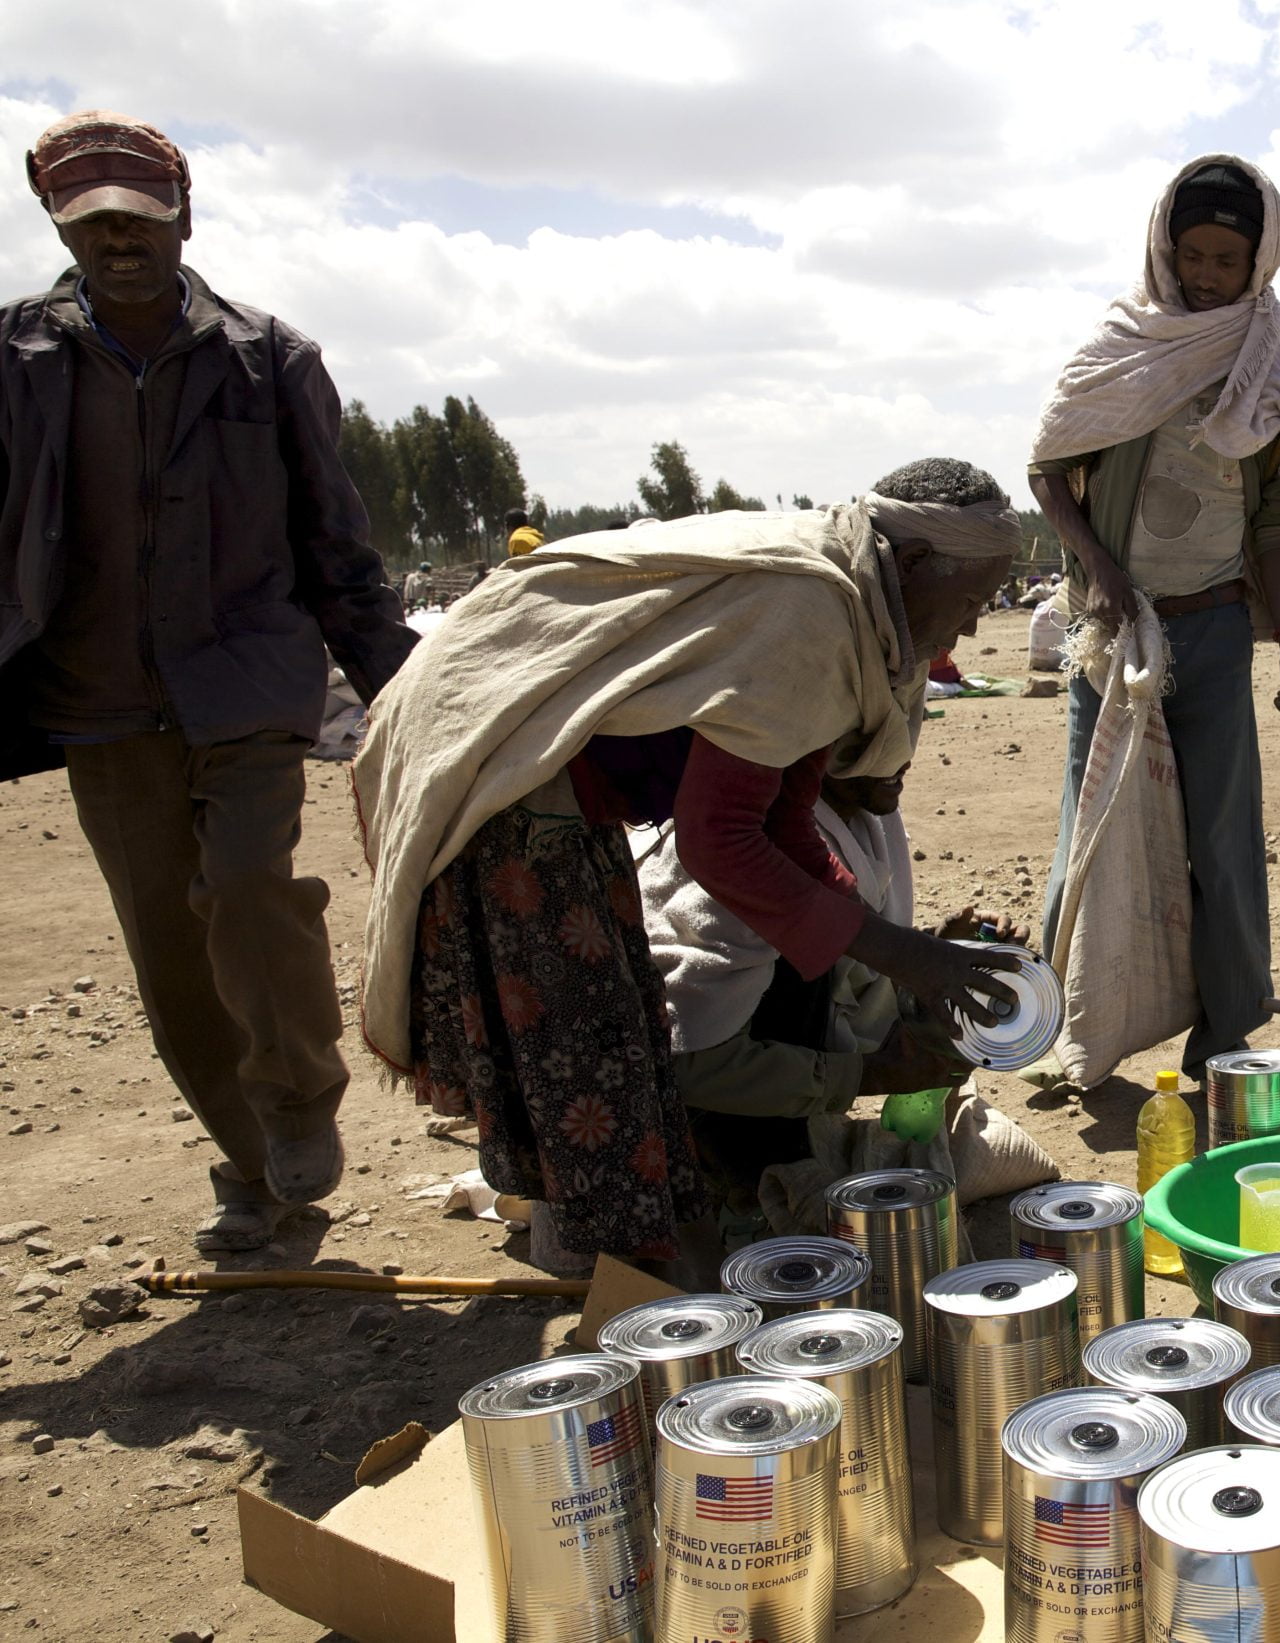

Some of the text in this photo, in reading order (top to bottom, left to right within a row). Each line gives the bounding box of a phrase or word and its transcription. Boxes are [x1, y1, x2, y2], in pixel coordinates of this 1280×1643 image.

[848, 1448, 867, 1461] OIL
[552, 1486, 608, 1513] REFINED
[552, 1503, 606, 1528] VITAMIN
[609, 1499, 618, 1511] A
[559, 1514, 633, 1548] NOT TO BE SOLD
[665, 1525, 812, 1555] REFINED VEGETABLE OIL
[664, 1541, 812, 1571] VITAMIN A & D FORTIFIED
[1009, 1542, 1129, 1581] REFINED VEGETABLE
[679, 1572, 690, 1584] TO
[691, 1577, 703, 1589] BE
[705, 1580, 732, 1591] SOLD
[734, 1581, 749, 1591] OR
[751, 1568, 809, 1590] EXCHANGED
[1009, 1558, 1043, 1588] VITAMIN
[1045, 1580, 1054, 1592] A
[1057, 1582, 1066, 1593] &
[1070, 1582, 1080, 1595] D
[1022, 1591, 1032, 1602] TO
[1033, 1598, 1044, 1608] BE
[1046, 1602, 1071, 1614] SOLD
[1073, 1606, 1088, 1616] OR
